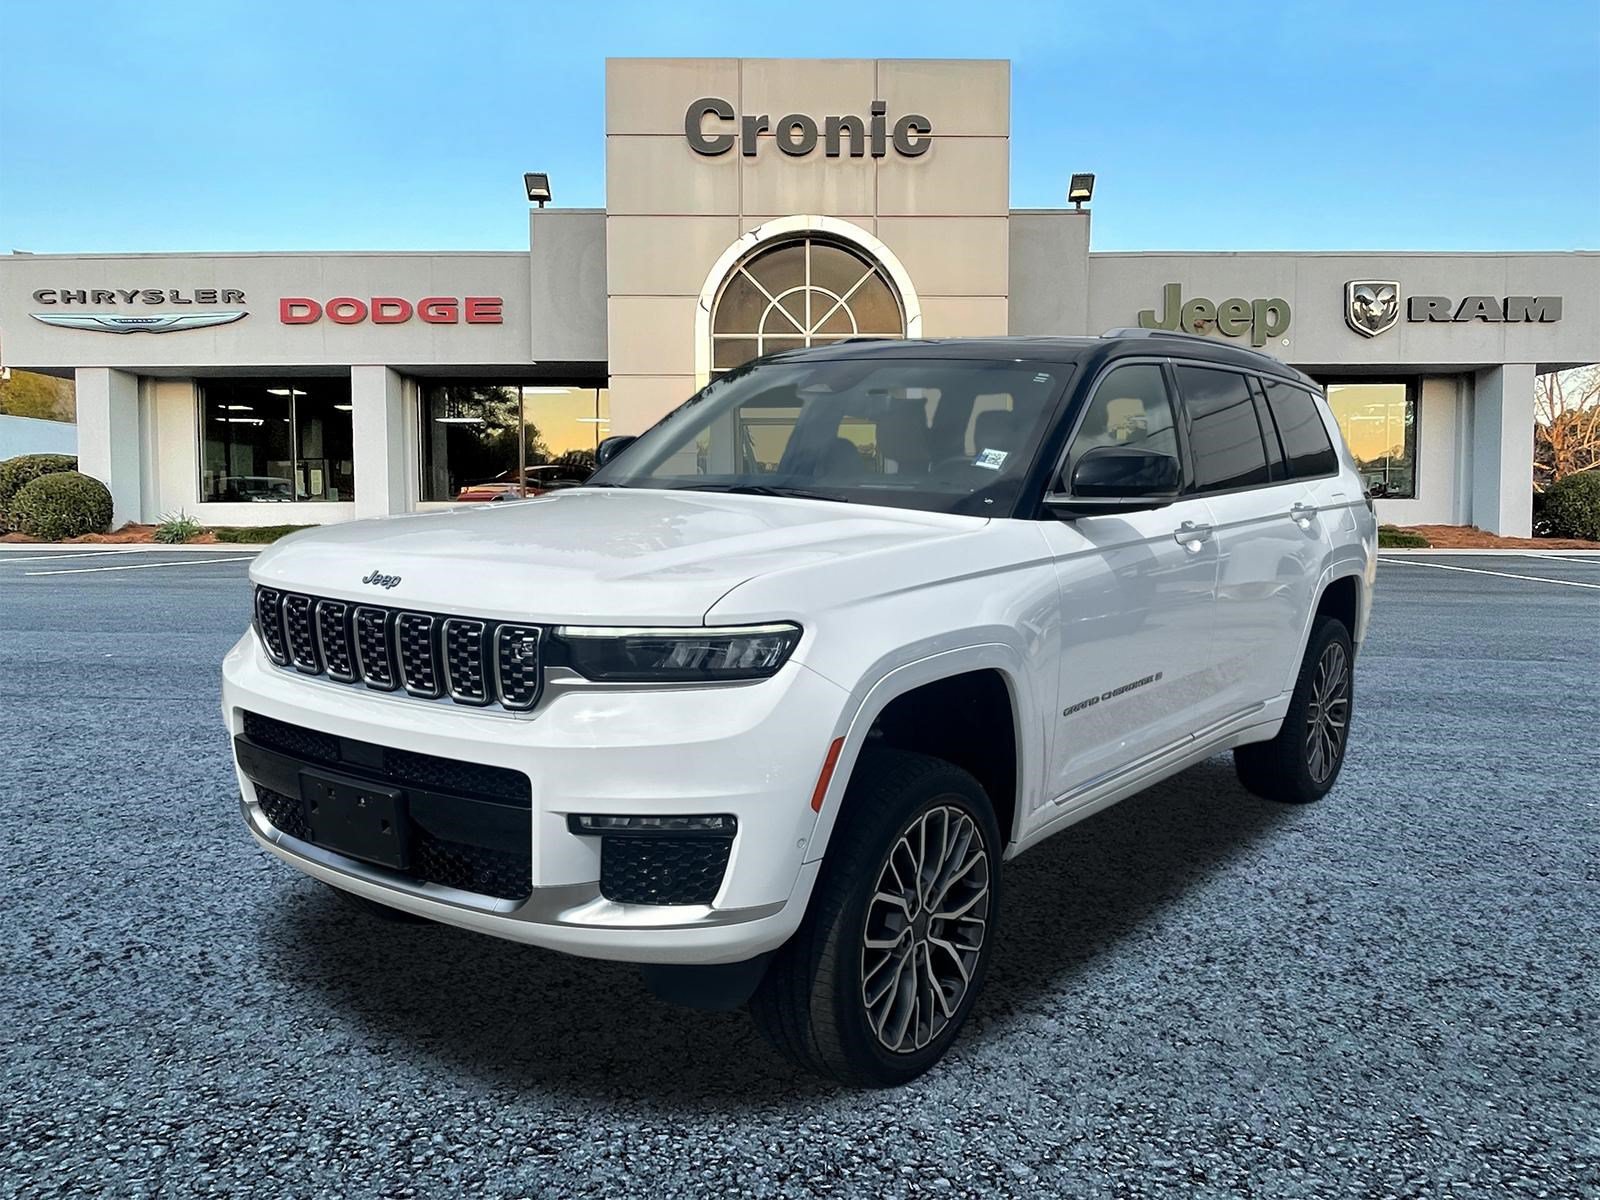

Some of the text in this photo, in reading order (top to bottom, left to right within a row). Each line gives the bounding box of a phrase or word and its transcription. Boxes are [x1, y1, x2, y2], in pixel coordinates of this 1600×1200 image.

[685, 97, 932, 157] Cronic
[32, 288, 246, 304] CHRYSLER
[1408, 296, 1563, 322] RAM
[279, 297, 504, 325] DODGE
[1138, 283, 1291, 347] Jeep
[362, 570, 402, 590] Jeep
[1063, 696, 1100, 717] GRAND
